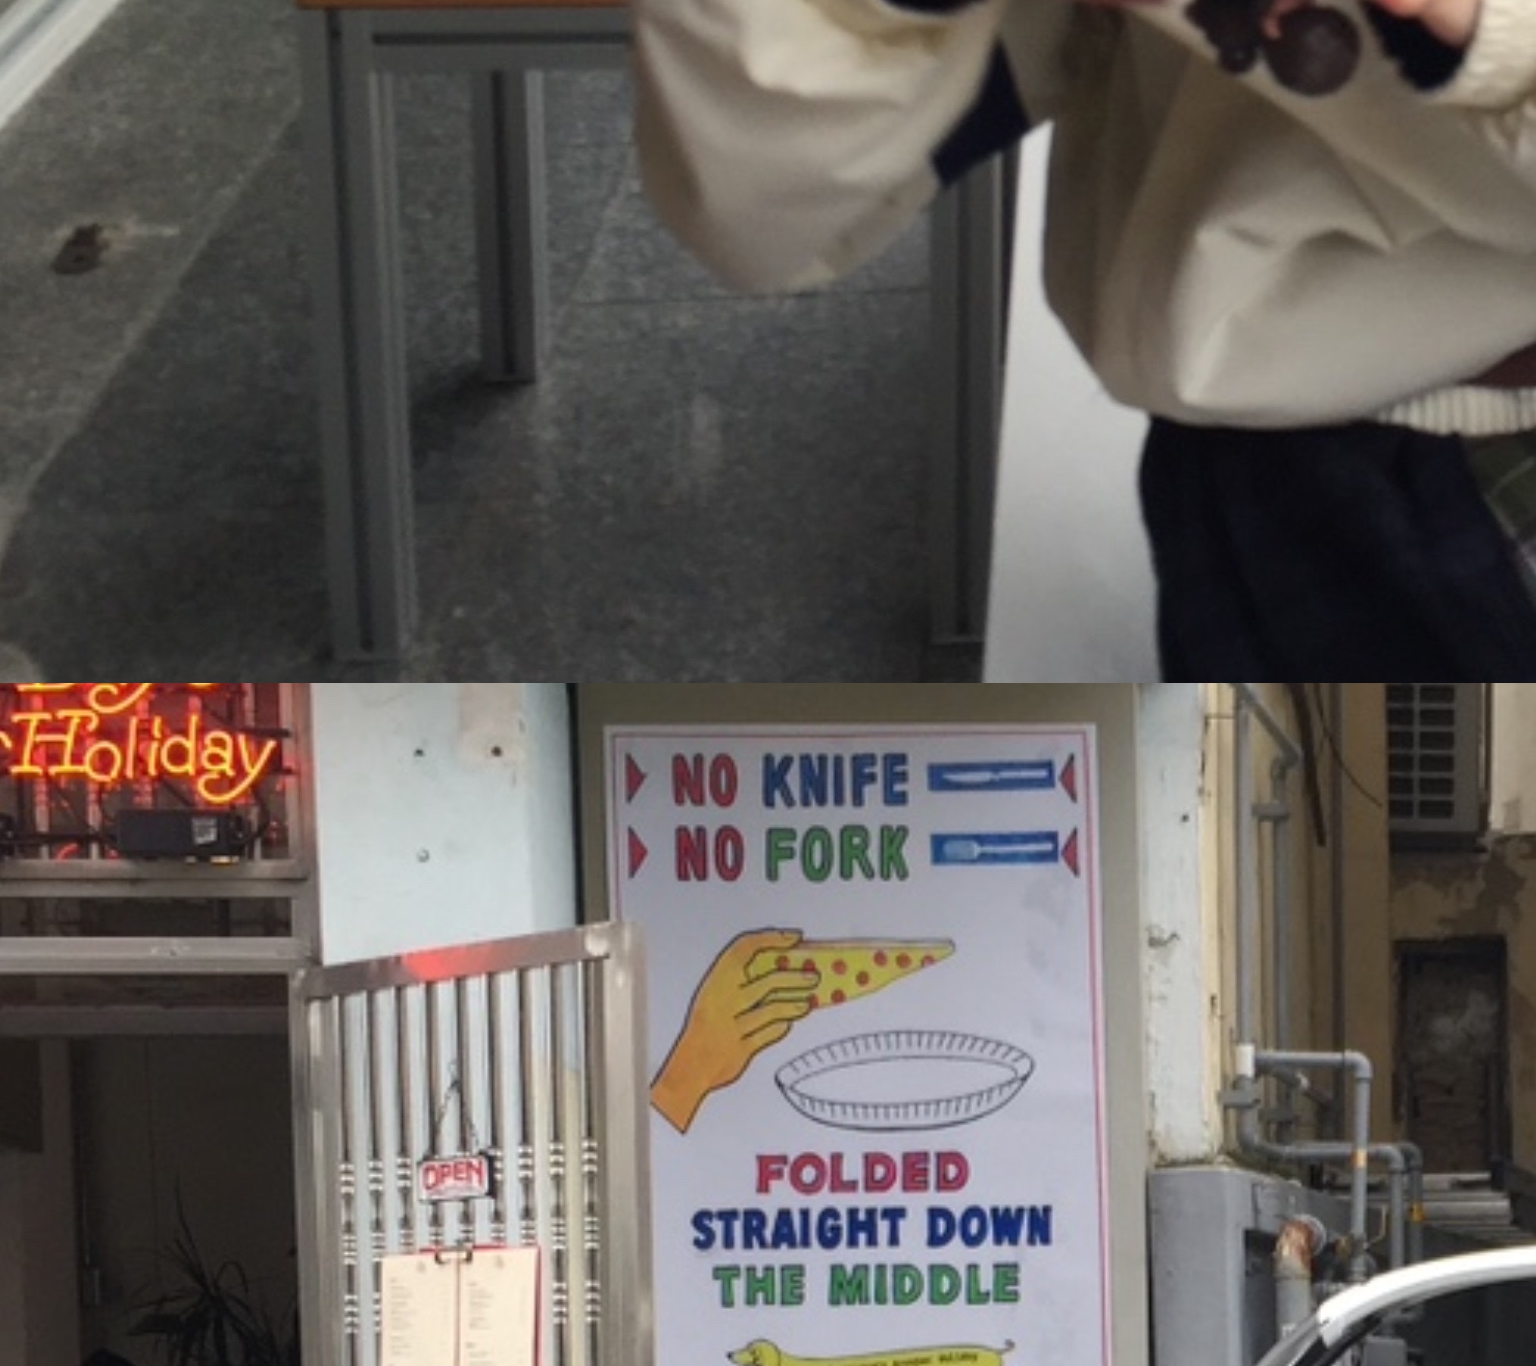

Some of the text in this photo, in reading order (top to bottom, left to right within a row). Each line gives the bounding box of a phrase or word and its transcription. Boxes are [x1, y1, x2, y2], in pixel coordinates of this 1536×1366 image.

[10, 708, 278, 805] Holiday
[671, 752, 910, 808] NO KNIFE
[675, 824, 910, 882] NO FORK
[422, 1159, 486, 1190] OPEN
[755, 1150, 972, 1195] FOLDED
[690, 1204, 1053, 1251] STRAIGHT DOWN
[712, 1262, 1021, 1309] THE MIDDLE
